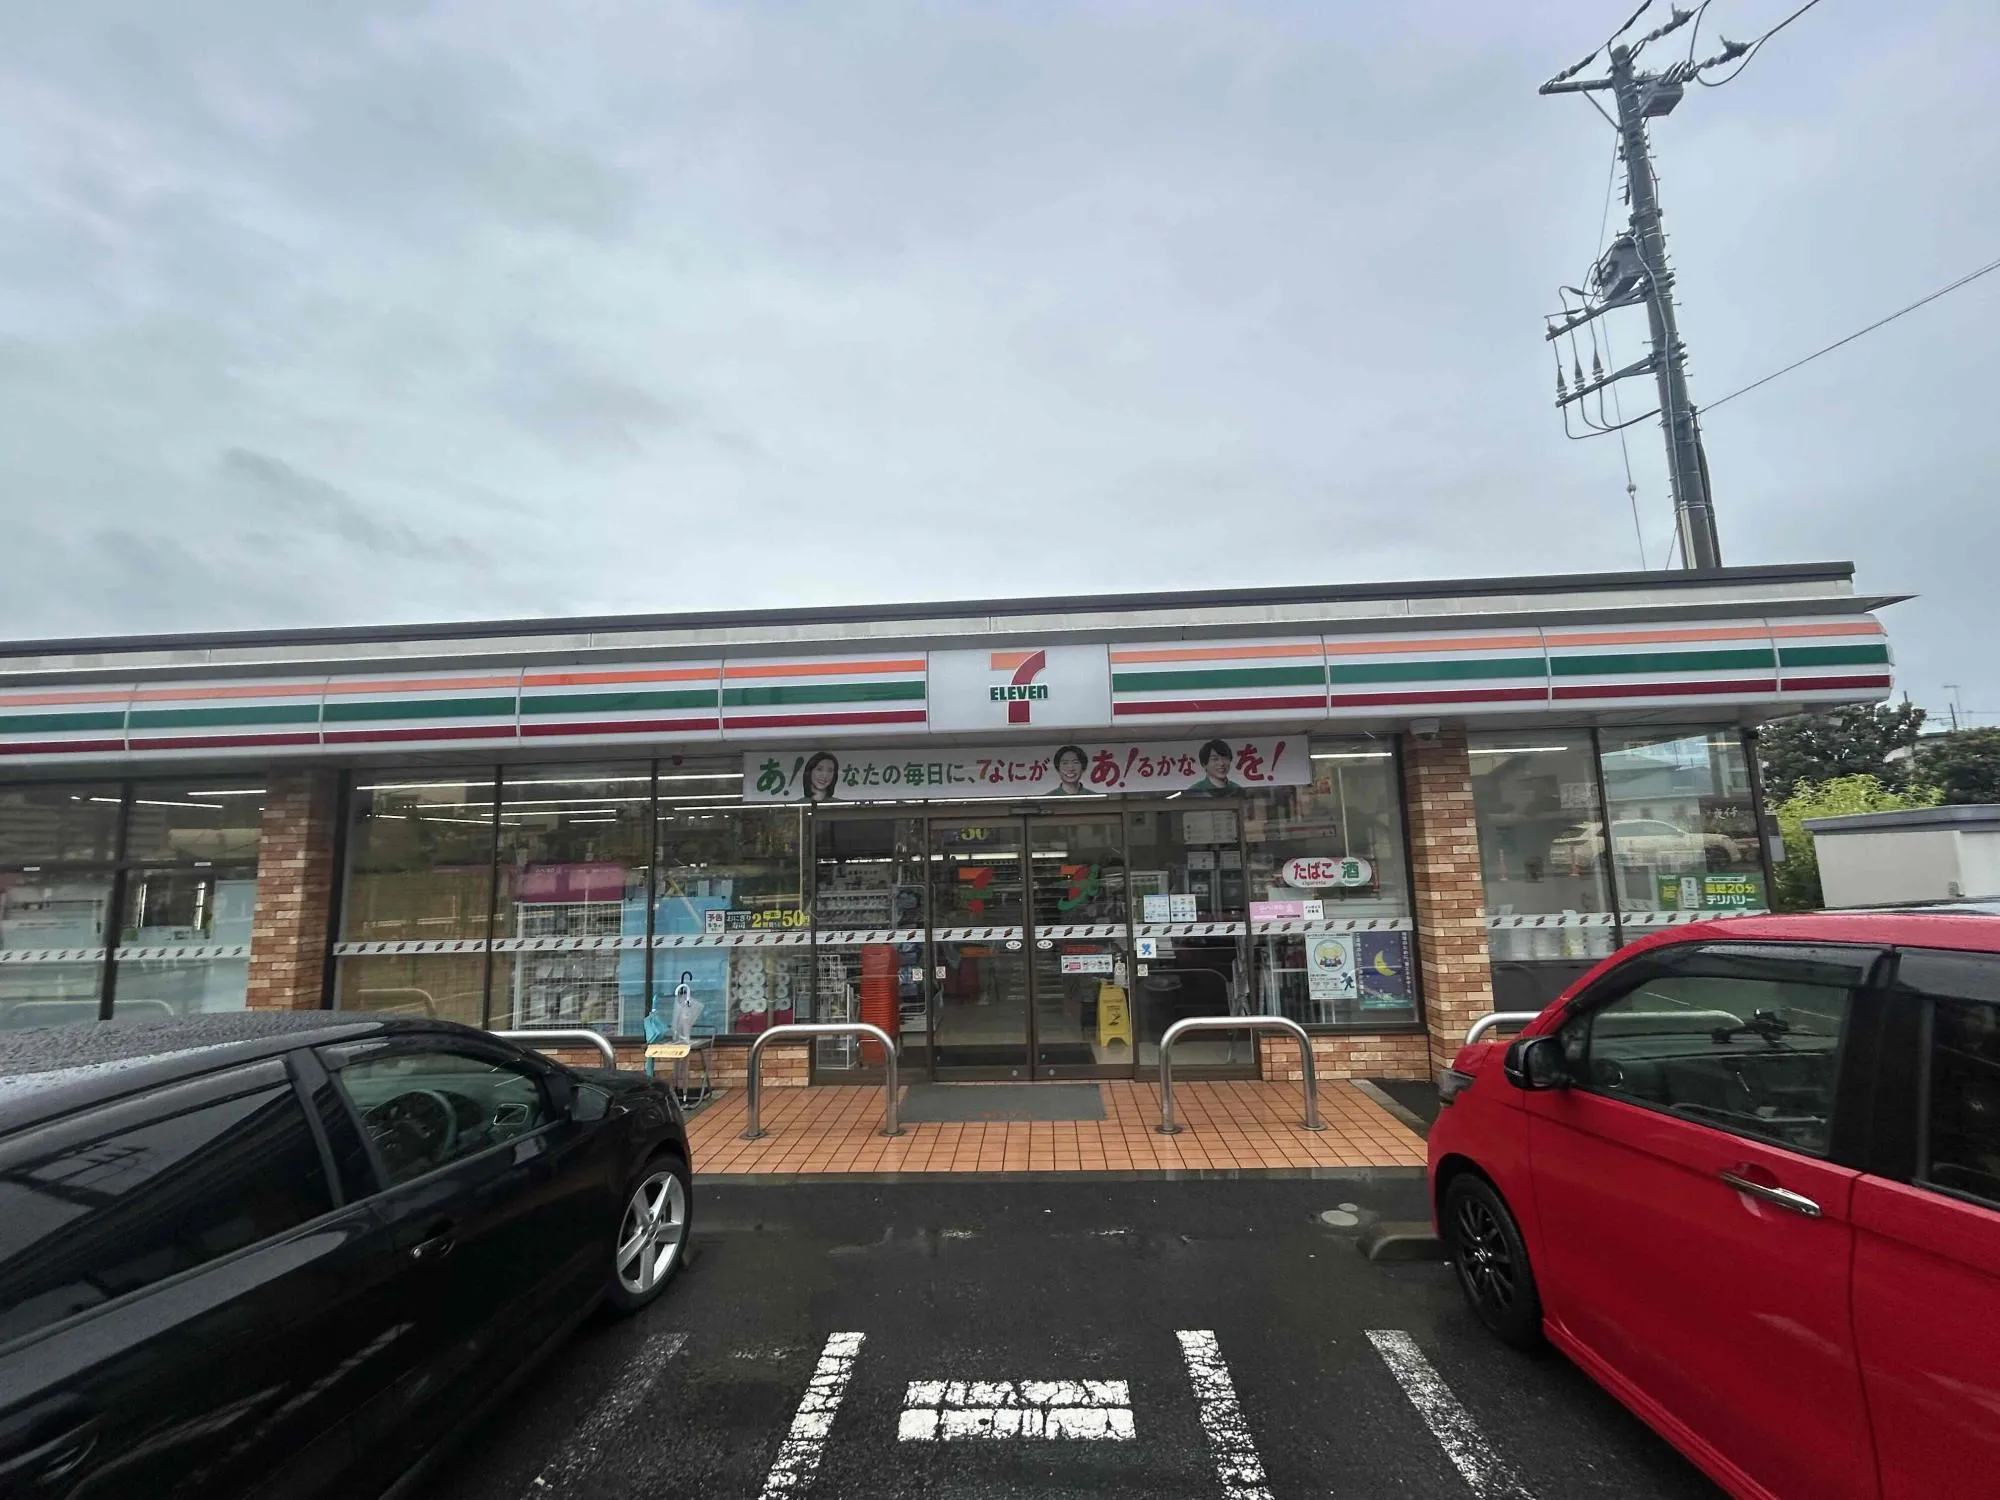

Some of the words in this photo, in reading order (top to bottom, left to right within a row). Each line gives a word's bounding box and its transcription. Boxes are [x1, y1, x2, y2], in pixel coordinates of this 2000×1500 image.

[1293, 862, 1334, 880] たばこ
[1341, 861, 1360, 879] 酒
